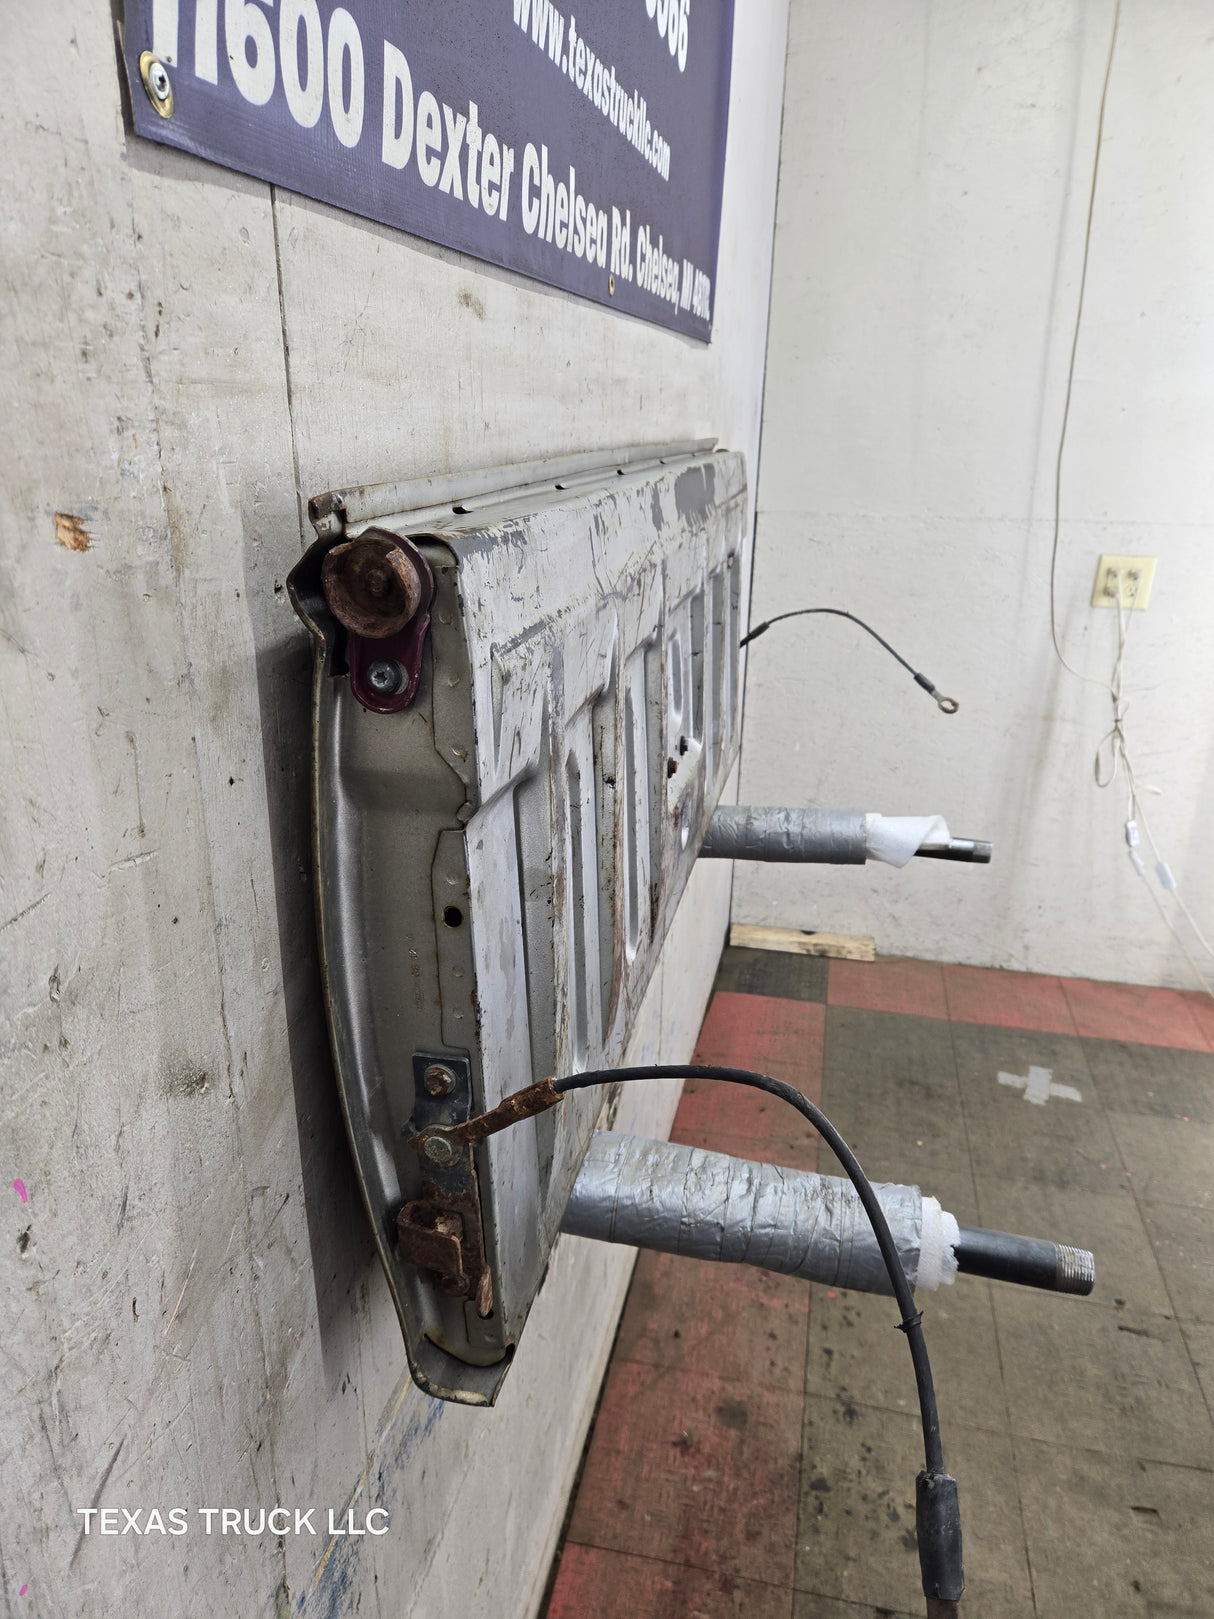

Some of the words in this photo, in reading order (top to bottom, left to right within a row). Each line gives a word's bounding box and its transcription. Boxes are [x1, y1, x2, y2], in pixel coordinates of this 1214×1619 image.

[381, 38, 514, 222] Dexter
[521, 142, 608, 269] Chelsea
[610, 205, 634, 283] Rd.
[636, 224, 680, 315] Chelsea,
